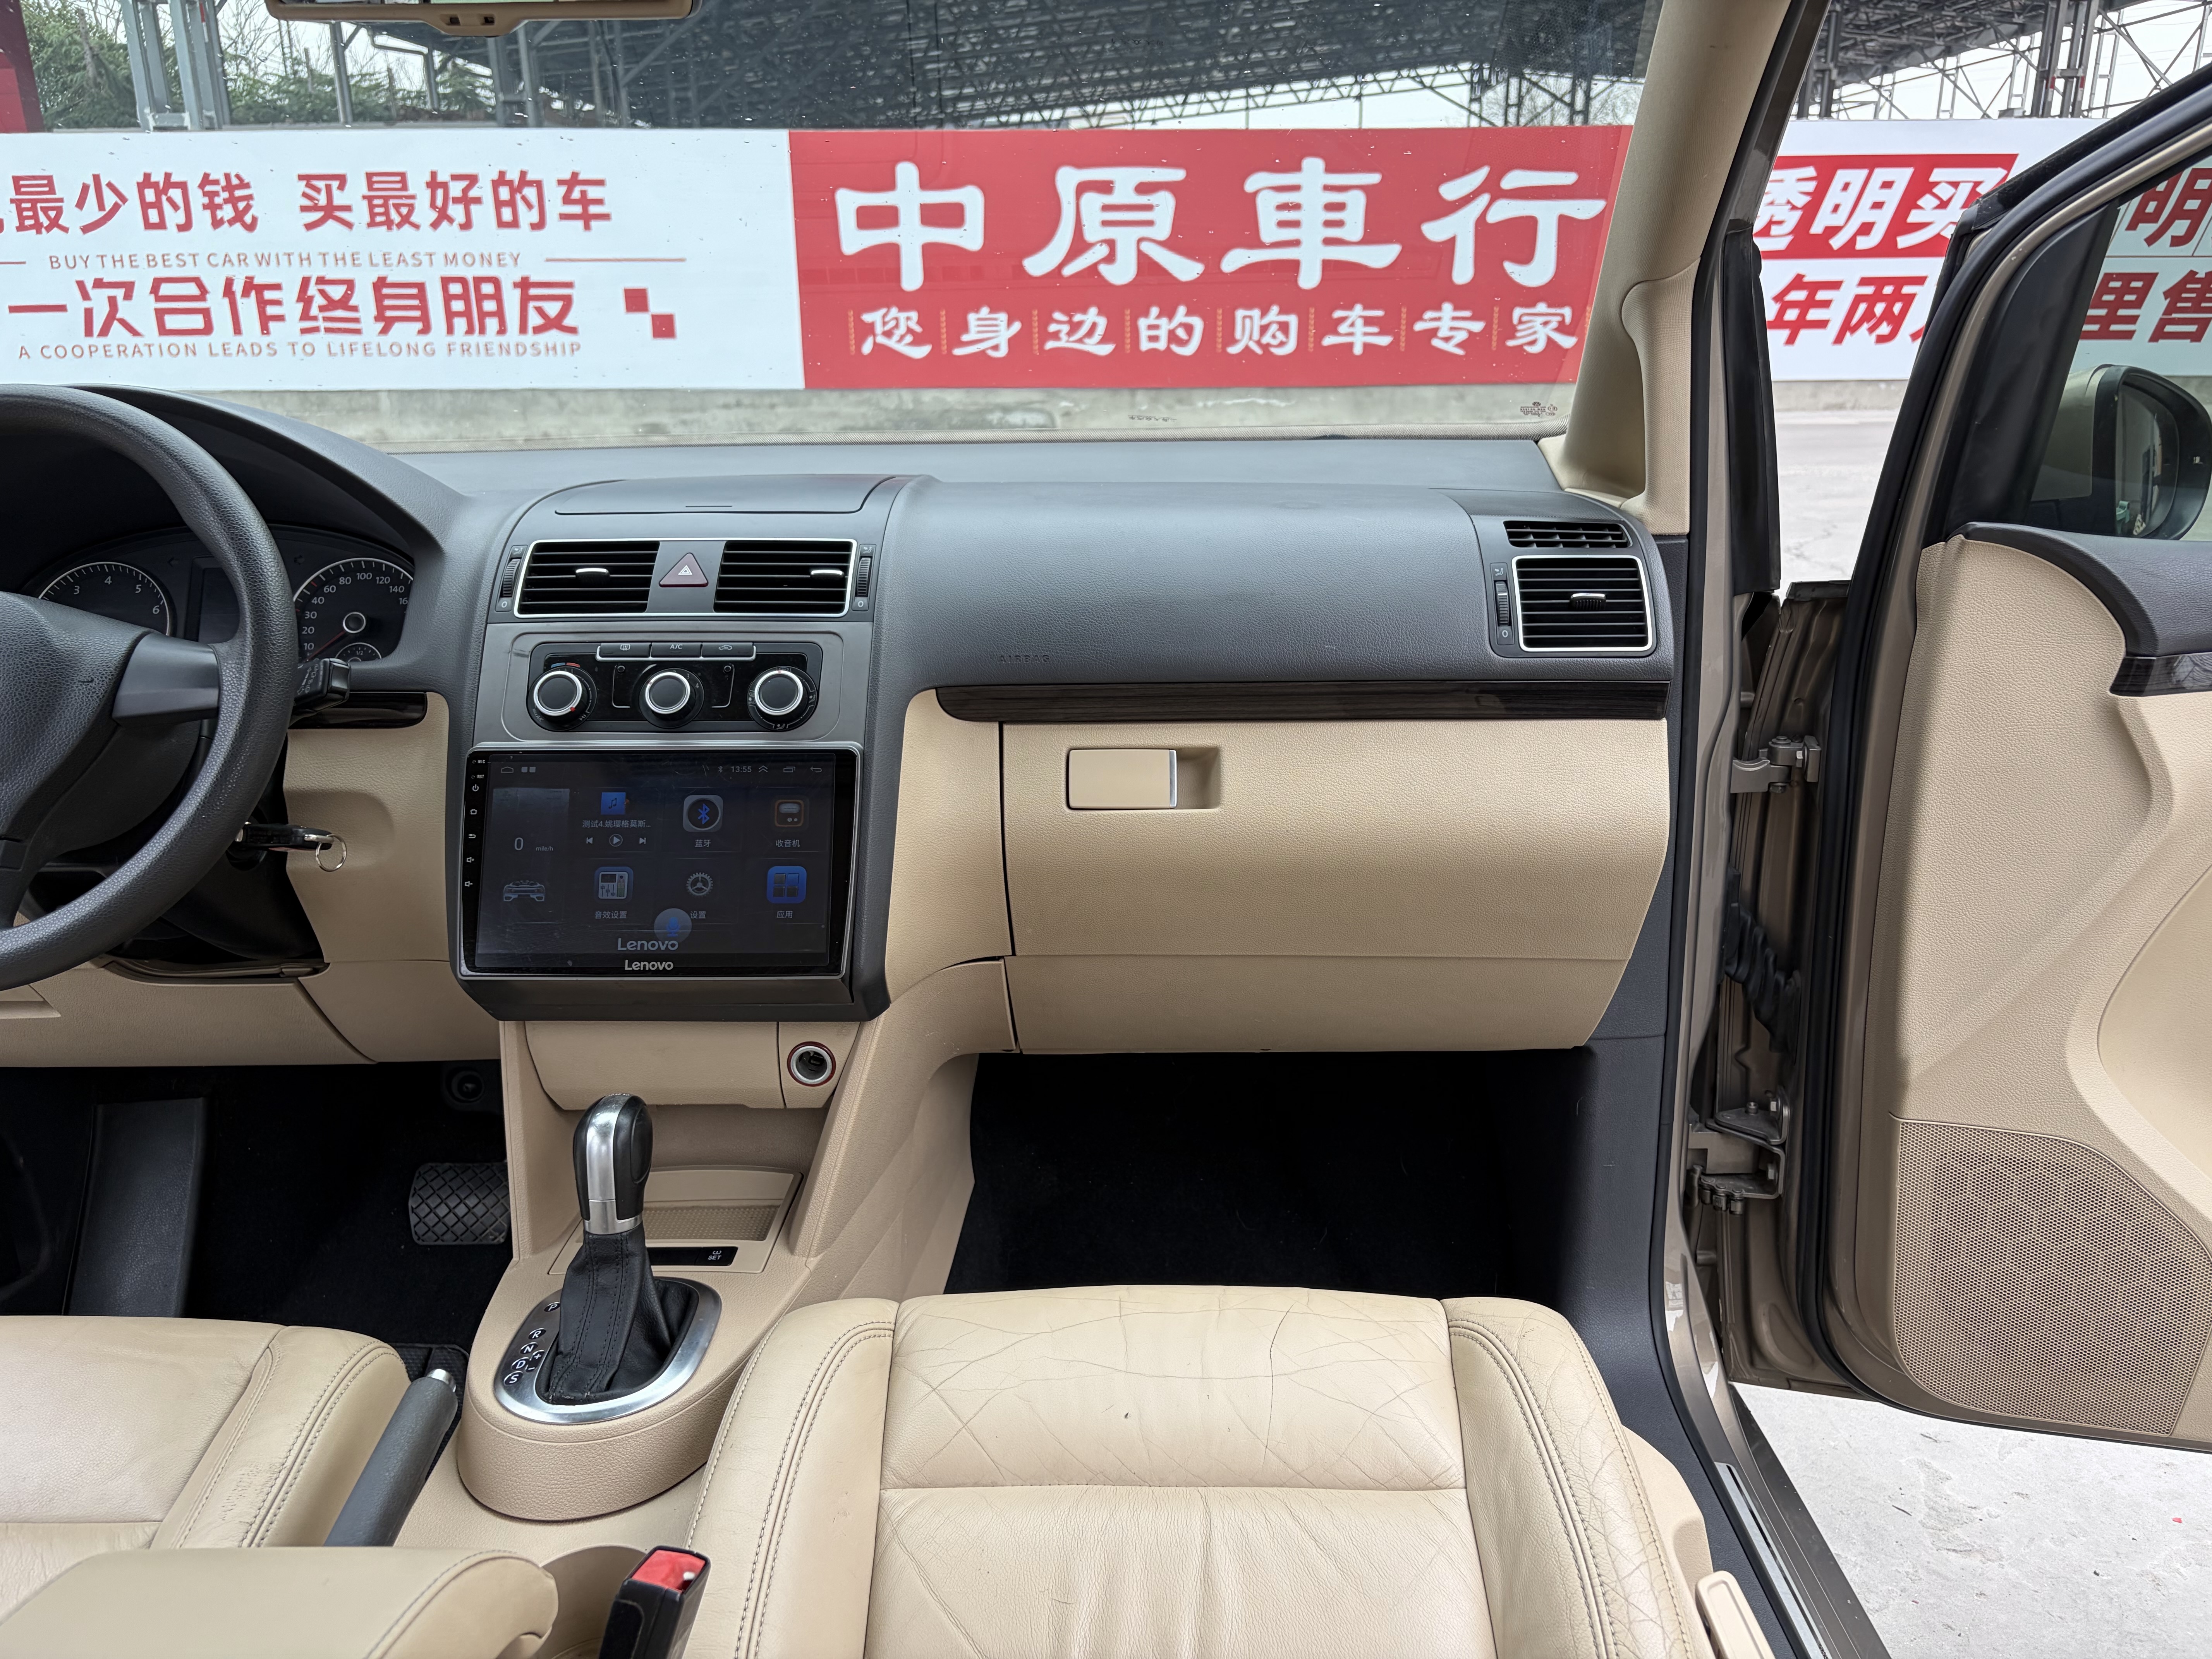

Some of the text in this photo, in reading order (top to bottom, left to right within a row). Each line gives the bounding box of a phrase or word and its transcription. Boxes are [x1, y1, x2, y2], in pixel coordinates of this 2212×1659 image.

[0, 170, 611, 235] 最少的钱 买最好的车
[1753, 166, 2008, 251] 透明买
[834, 156, 1607, 291] 中原車行
[49, 252, 521, 269] BUY THE BEST CAR WITH THE LEAST MONEY
[8, 275, 579, 337] 一次合作终身朋友
[1766, 273, 1925, 346] 年两
[860, 302, 1578, 359] 您身边的购车专家
[19, 342, 582, 359] A COOPERATION LEADS TO LIFELONG FRIENDSHIP
[104, 576, 112, 585] 4
[339, 577, 352, 585] 80
[376, 576, 391, 584] 120
[73, 585, 80, 595] 3
[135, 584, 142, 594] 5
[389, 585, 405, 593] 140
[311, 596, 325, 605] 40
[152, 605, 160, 614] 6
[302, 626, 314, 634] 20
[514, 837, 524, 851] 0
[695, 839, 711, 847] 蓝牙
[775, 839, 800, 847] 收音机
[594, 910, 627, 919] 音效设置
[690, 911, 707, 919] 设置
[617, 938, 679, 951] Lenovo
[624, 959, 674, 970] Lenovo
[532, 1330, 542, 1339] R
[523, 1345, 534, 1353] N
[516, 1360, 526, 1369] D
[509, 1374, 519, 1384] S
